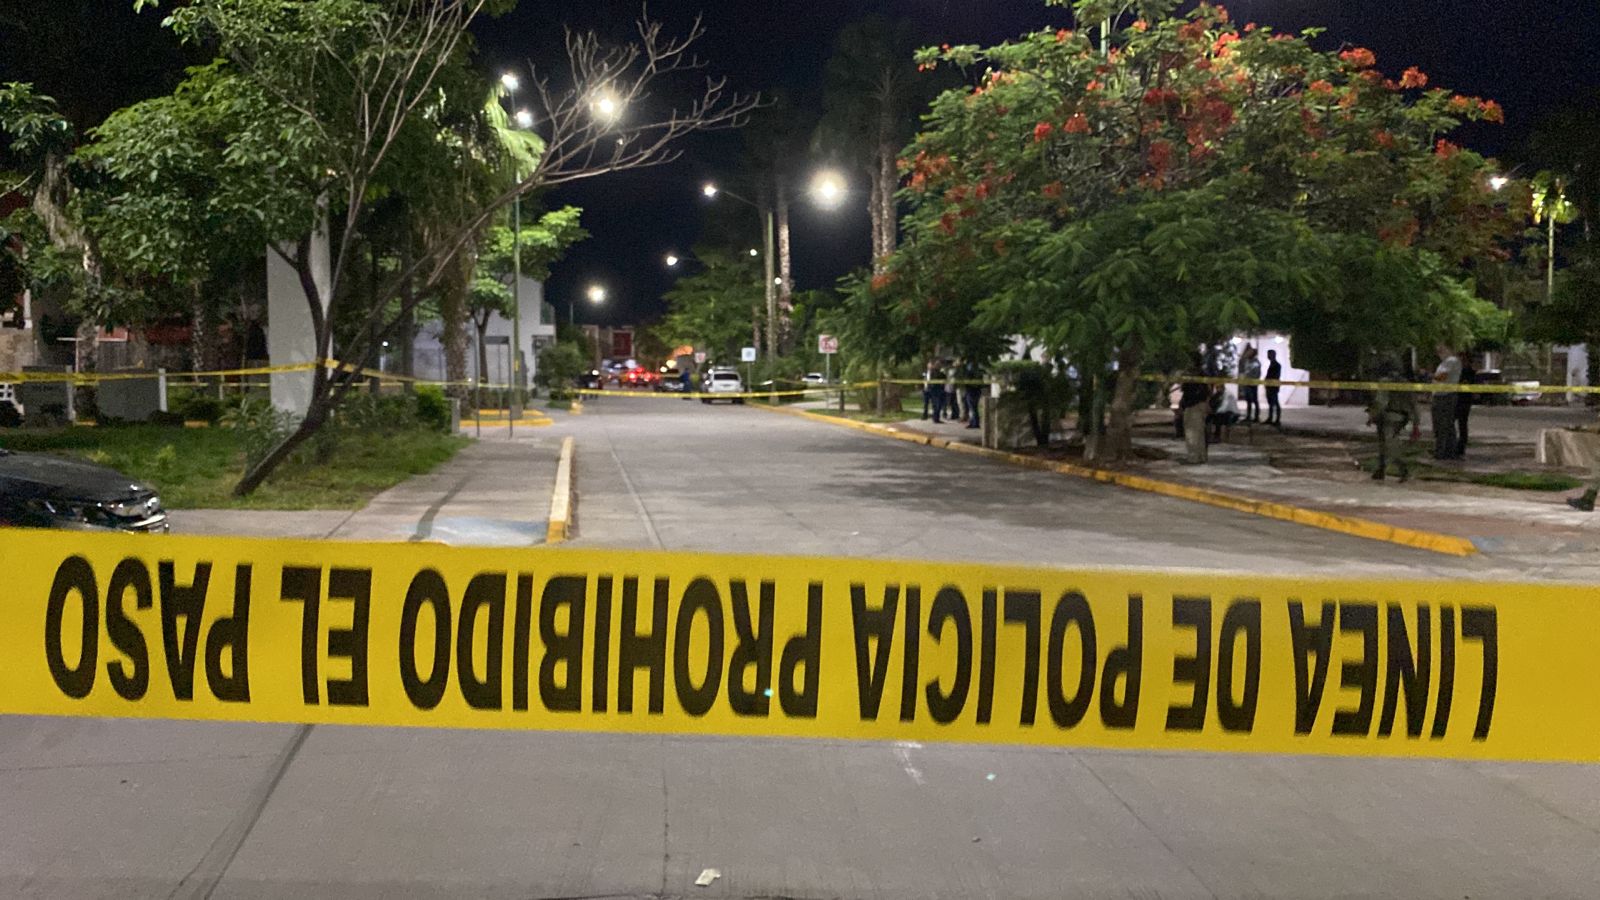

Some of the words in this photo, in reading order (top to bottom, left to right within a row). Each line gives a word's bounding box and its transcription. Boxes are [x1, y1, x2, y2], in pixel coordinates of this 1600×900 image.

[44, 553, 253, 704] PASO
[279, 564, 373, 708] EL
[398, 567, 824, 719] PROHIBIDO
[849, 582, 1144, 731] POLICIA
[1164, 594, 1262, 735] DE
[1286, 598, 1499, 742] LINEA
